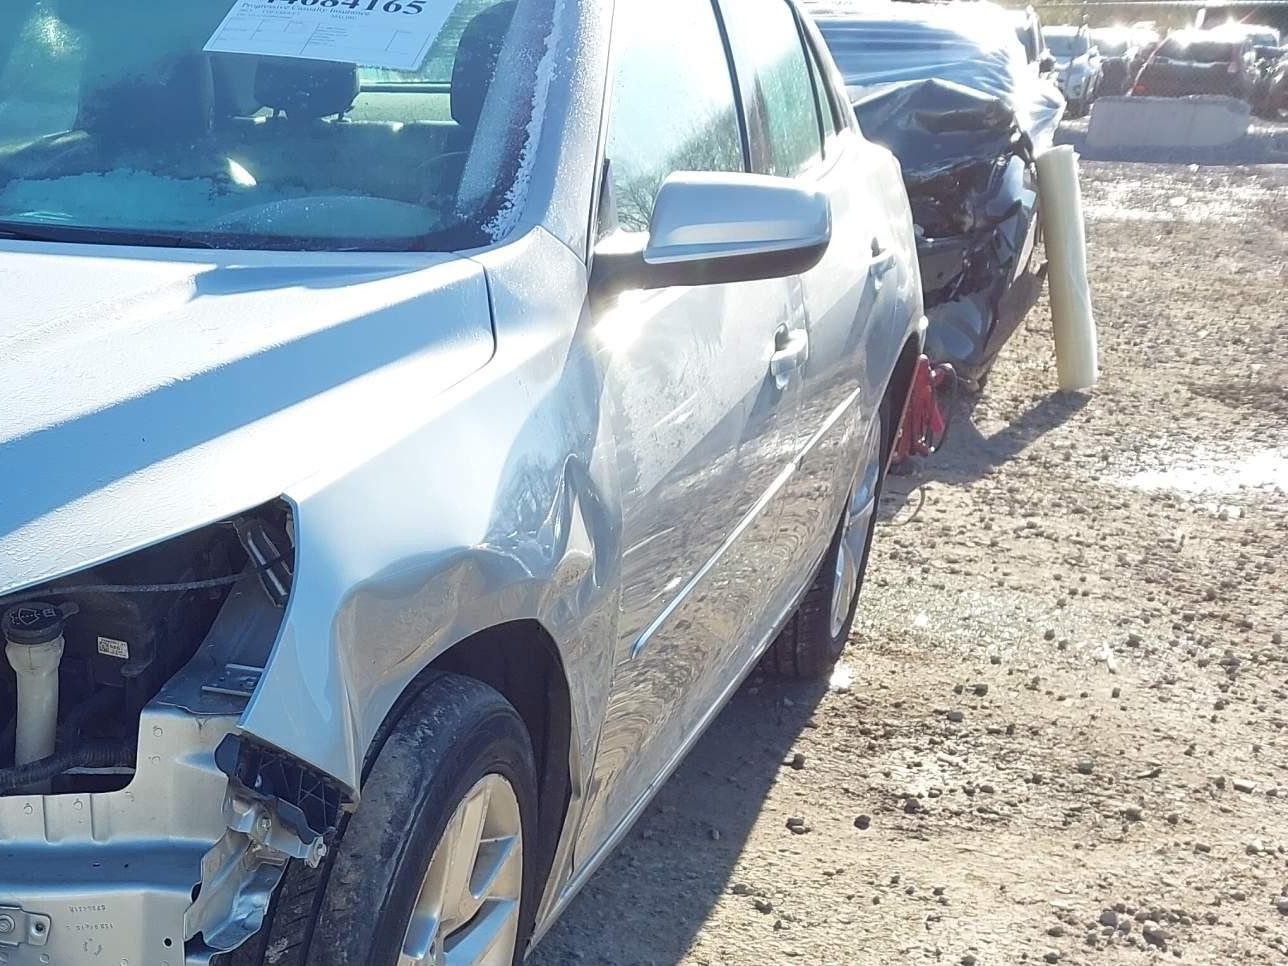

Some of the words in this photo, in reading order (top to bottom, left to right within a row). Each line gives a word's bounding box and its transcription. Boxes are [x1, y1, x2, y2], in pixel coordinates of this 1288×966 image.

[241, 3, 287, 11] Progressive
[291, 5, 327, 13] Casualty
[329, 7, 371, 16] Insurance
[268, 0, 426, 15] 84165
